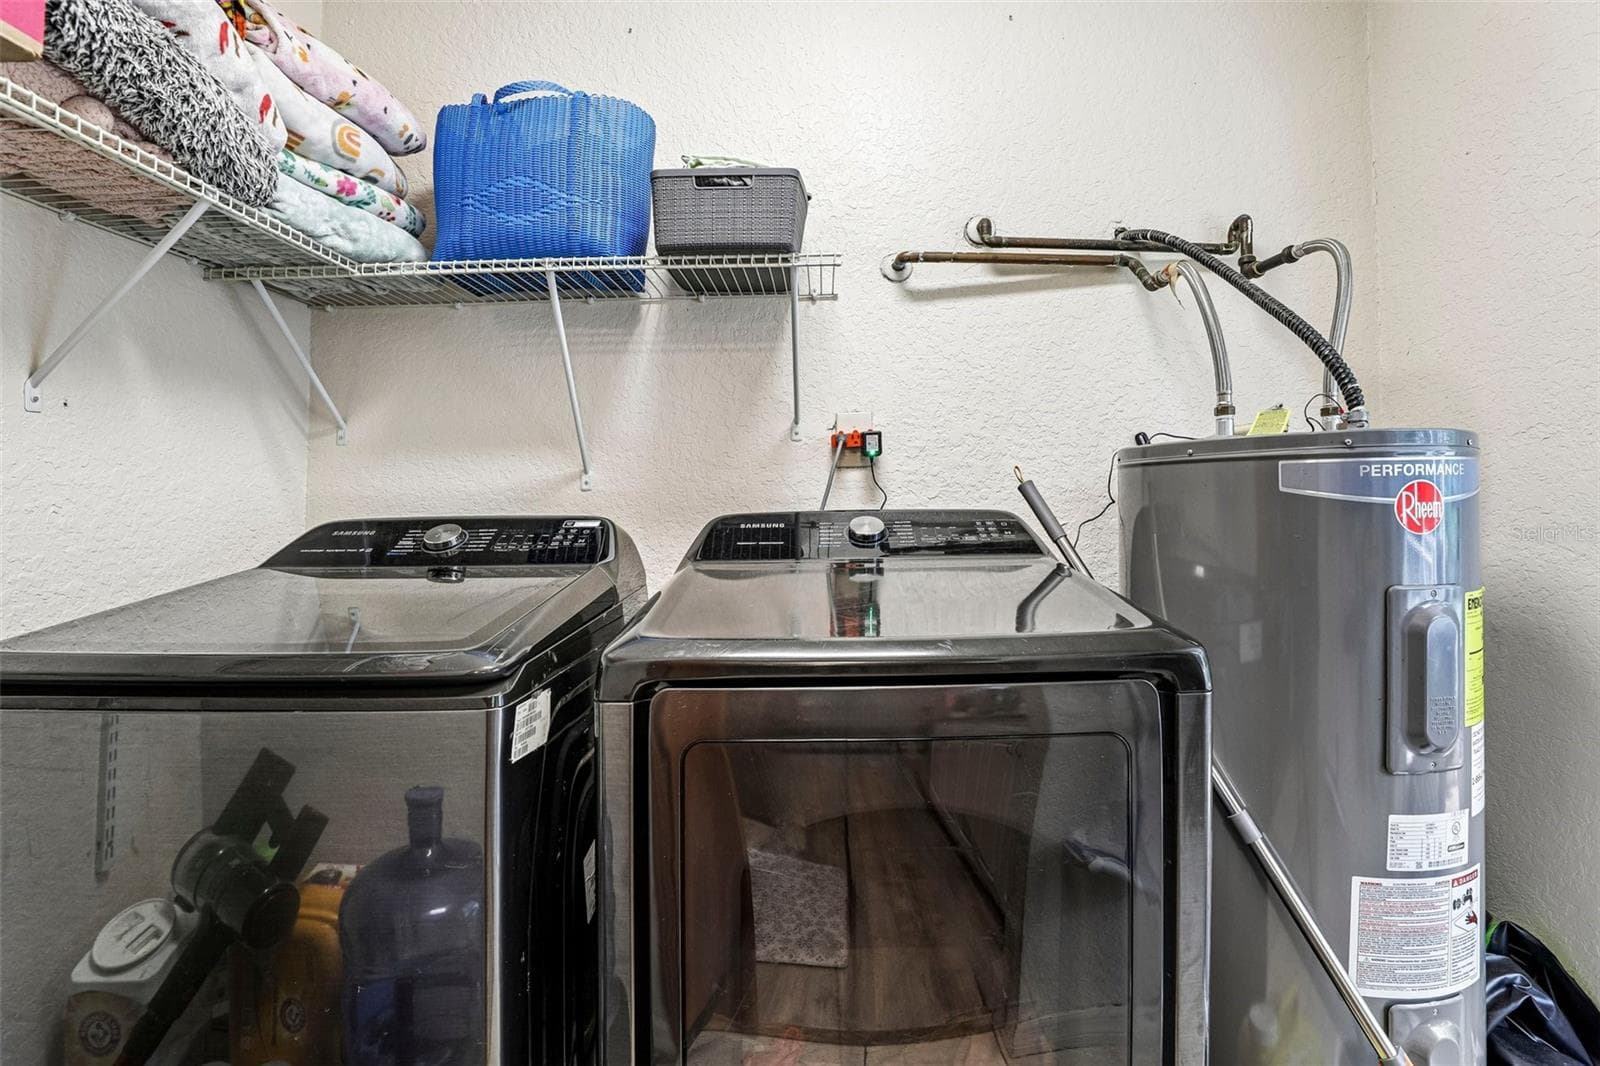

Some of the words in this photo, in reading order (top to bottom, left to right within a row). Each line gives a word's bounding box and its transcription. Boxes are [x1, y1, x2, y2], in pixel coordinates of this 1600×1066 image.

[1359, 463, 1465, 477] PERFORMANCE
[1400, 482, 1442, 527] Rheem
[331, 529, 377, 537] SAMSUNG
